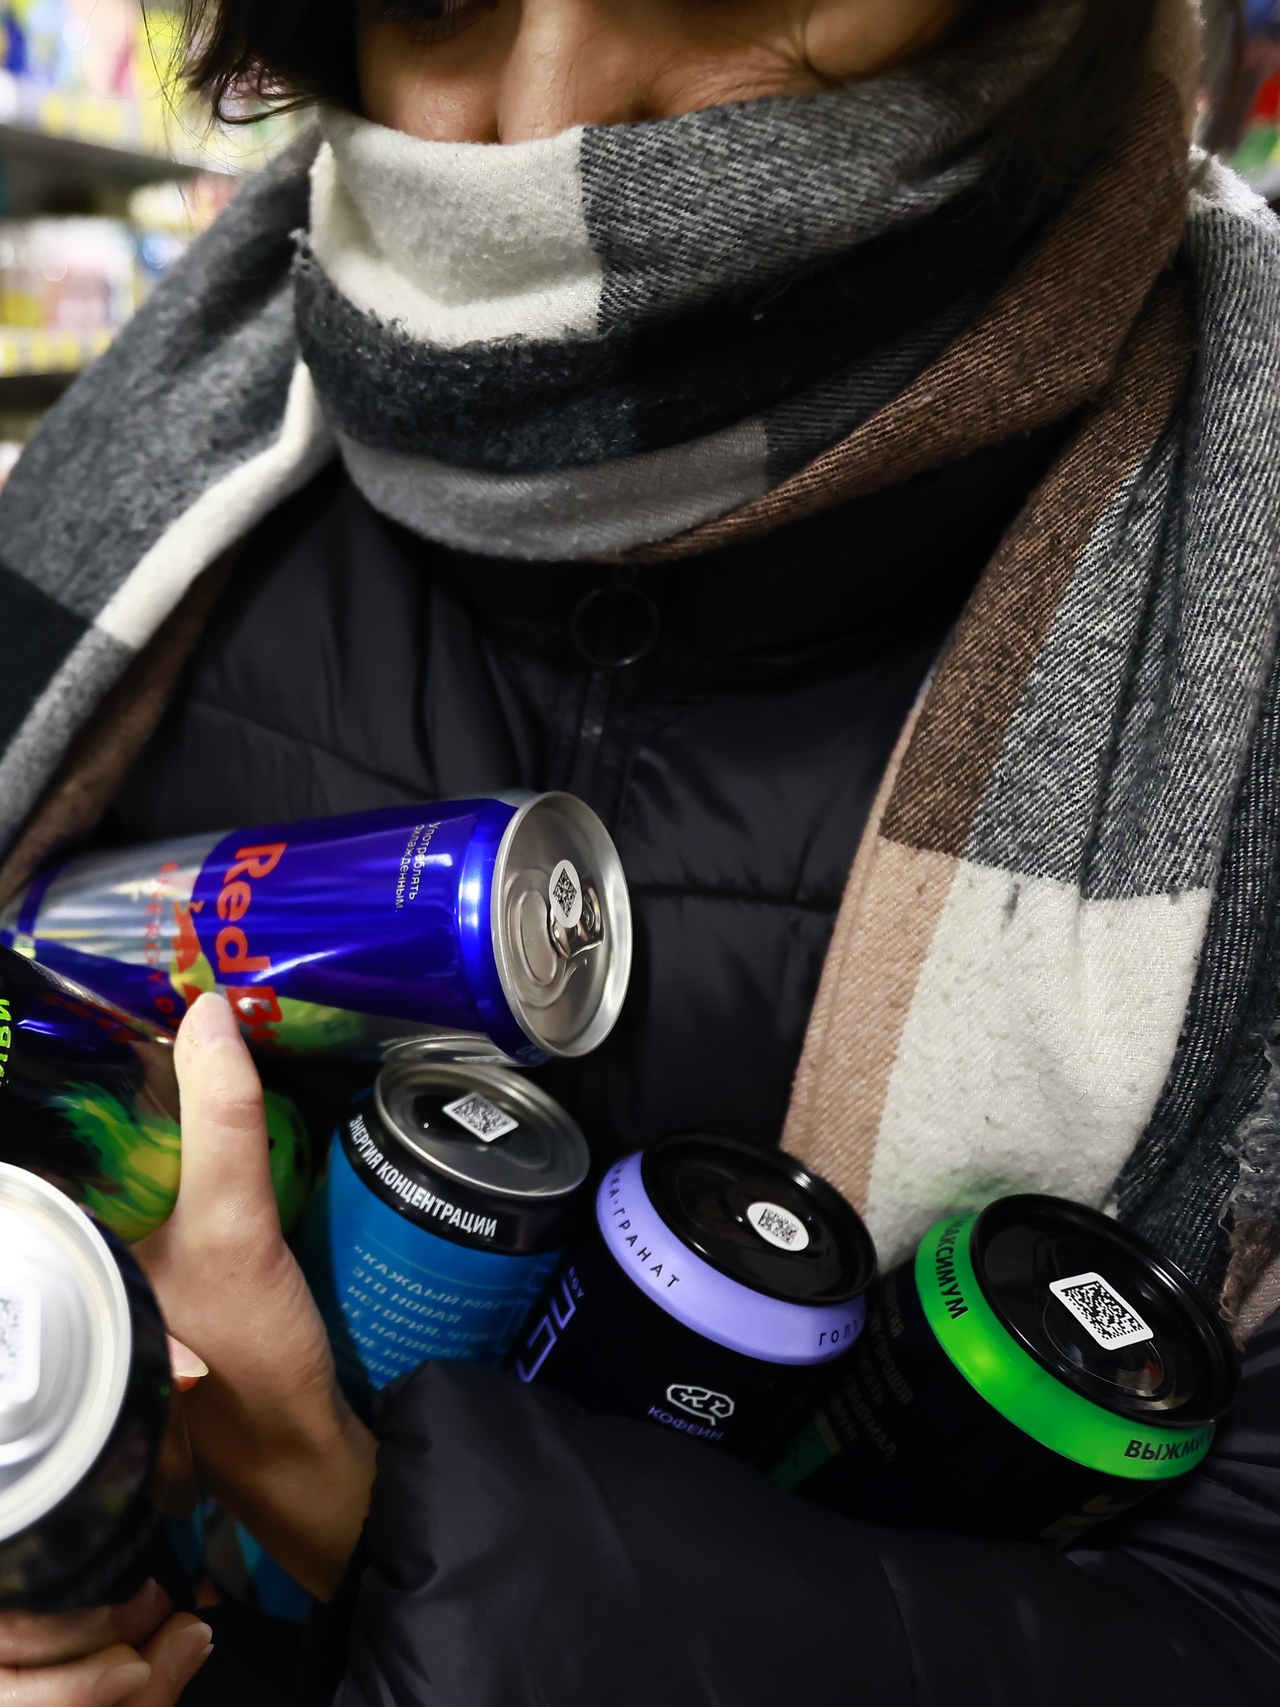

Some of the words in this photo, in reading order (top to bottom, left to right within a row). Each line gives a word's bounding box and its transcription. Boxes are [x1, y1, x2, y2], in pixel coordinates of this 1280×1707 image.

[215, 842, 288, 974] Red
[409, 821, 441, 900] Употреблять
[349, 1112, 384, 1170] ЭНЕРГИЯ
[376, 1160, 498, 1237] КОНЦЕНТРАЦИИ
